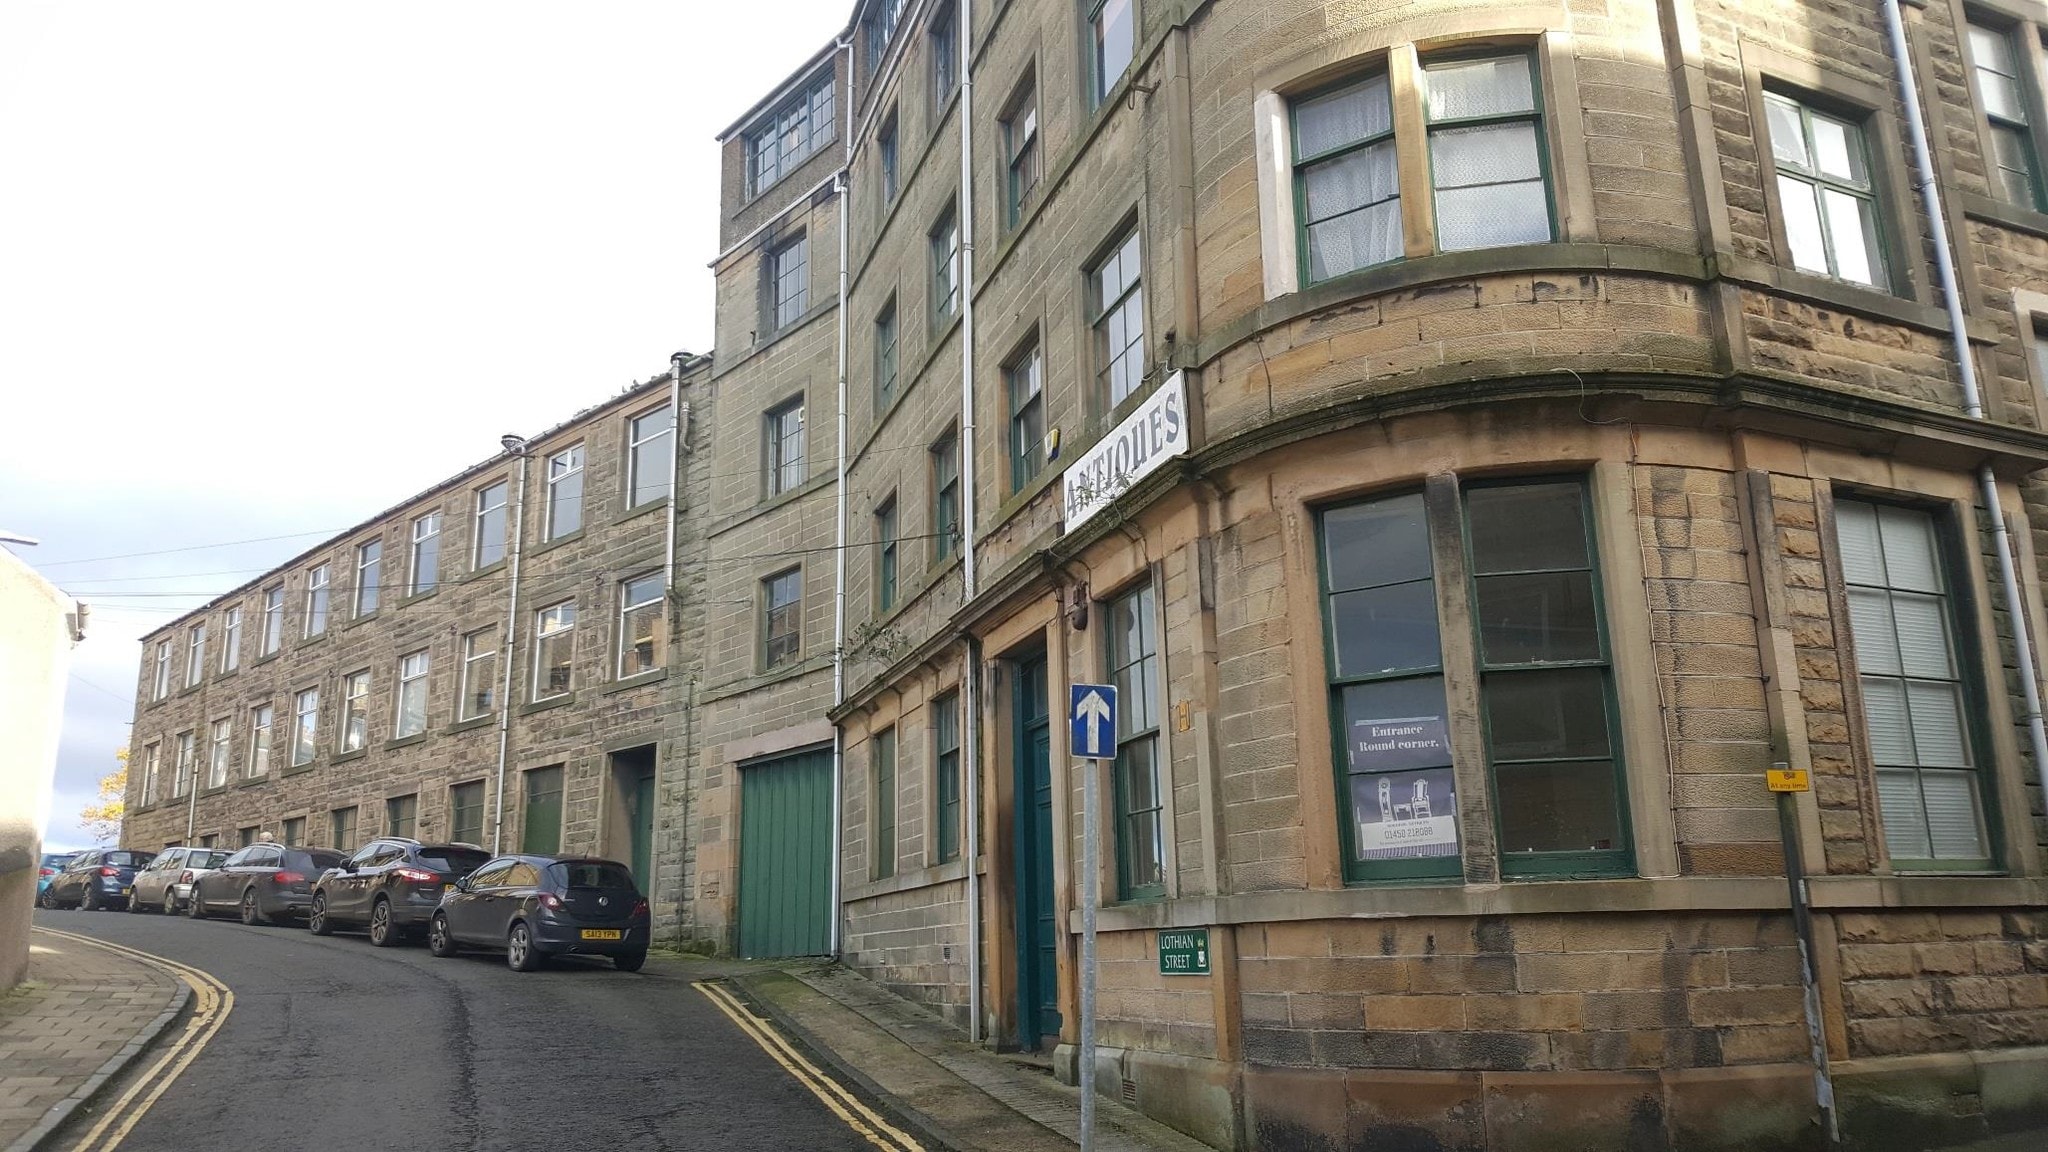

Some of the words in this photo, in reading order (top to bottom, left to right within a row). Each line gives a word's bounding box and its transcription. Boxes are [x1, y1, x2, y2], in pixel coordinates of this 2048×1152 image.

[1066, 391, 1179, 522] ANTIQUES
[1372, 725, 1423, 737] Entrance
[1359, 739, 1395, 752] Round
[1398, 738, 1439, 750] corner.
[1160, 934, 1194, 949] LOTHIAN
[1165, 954, 1190, 968] STREET
